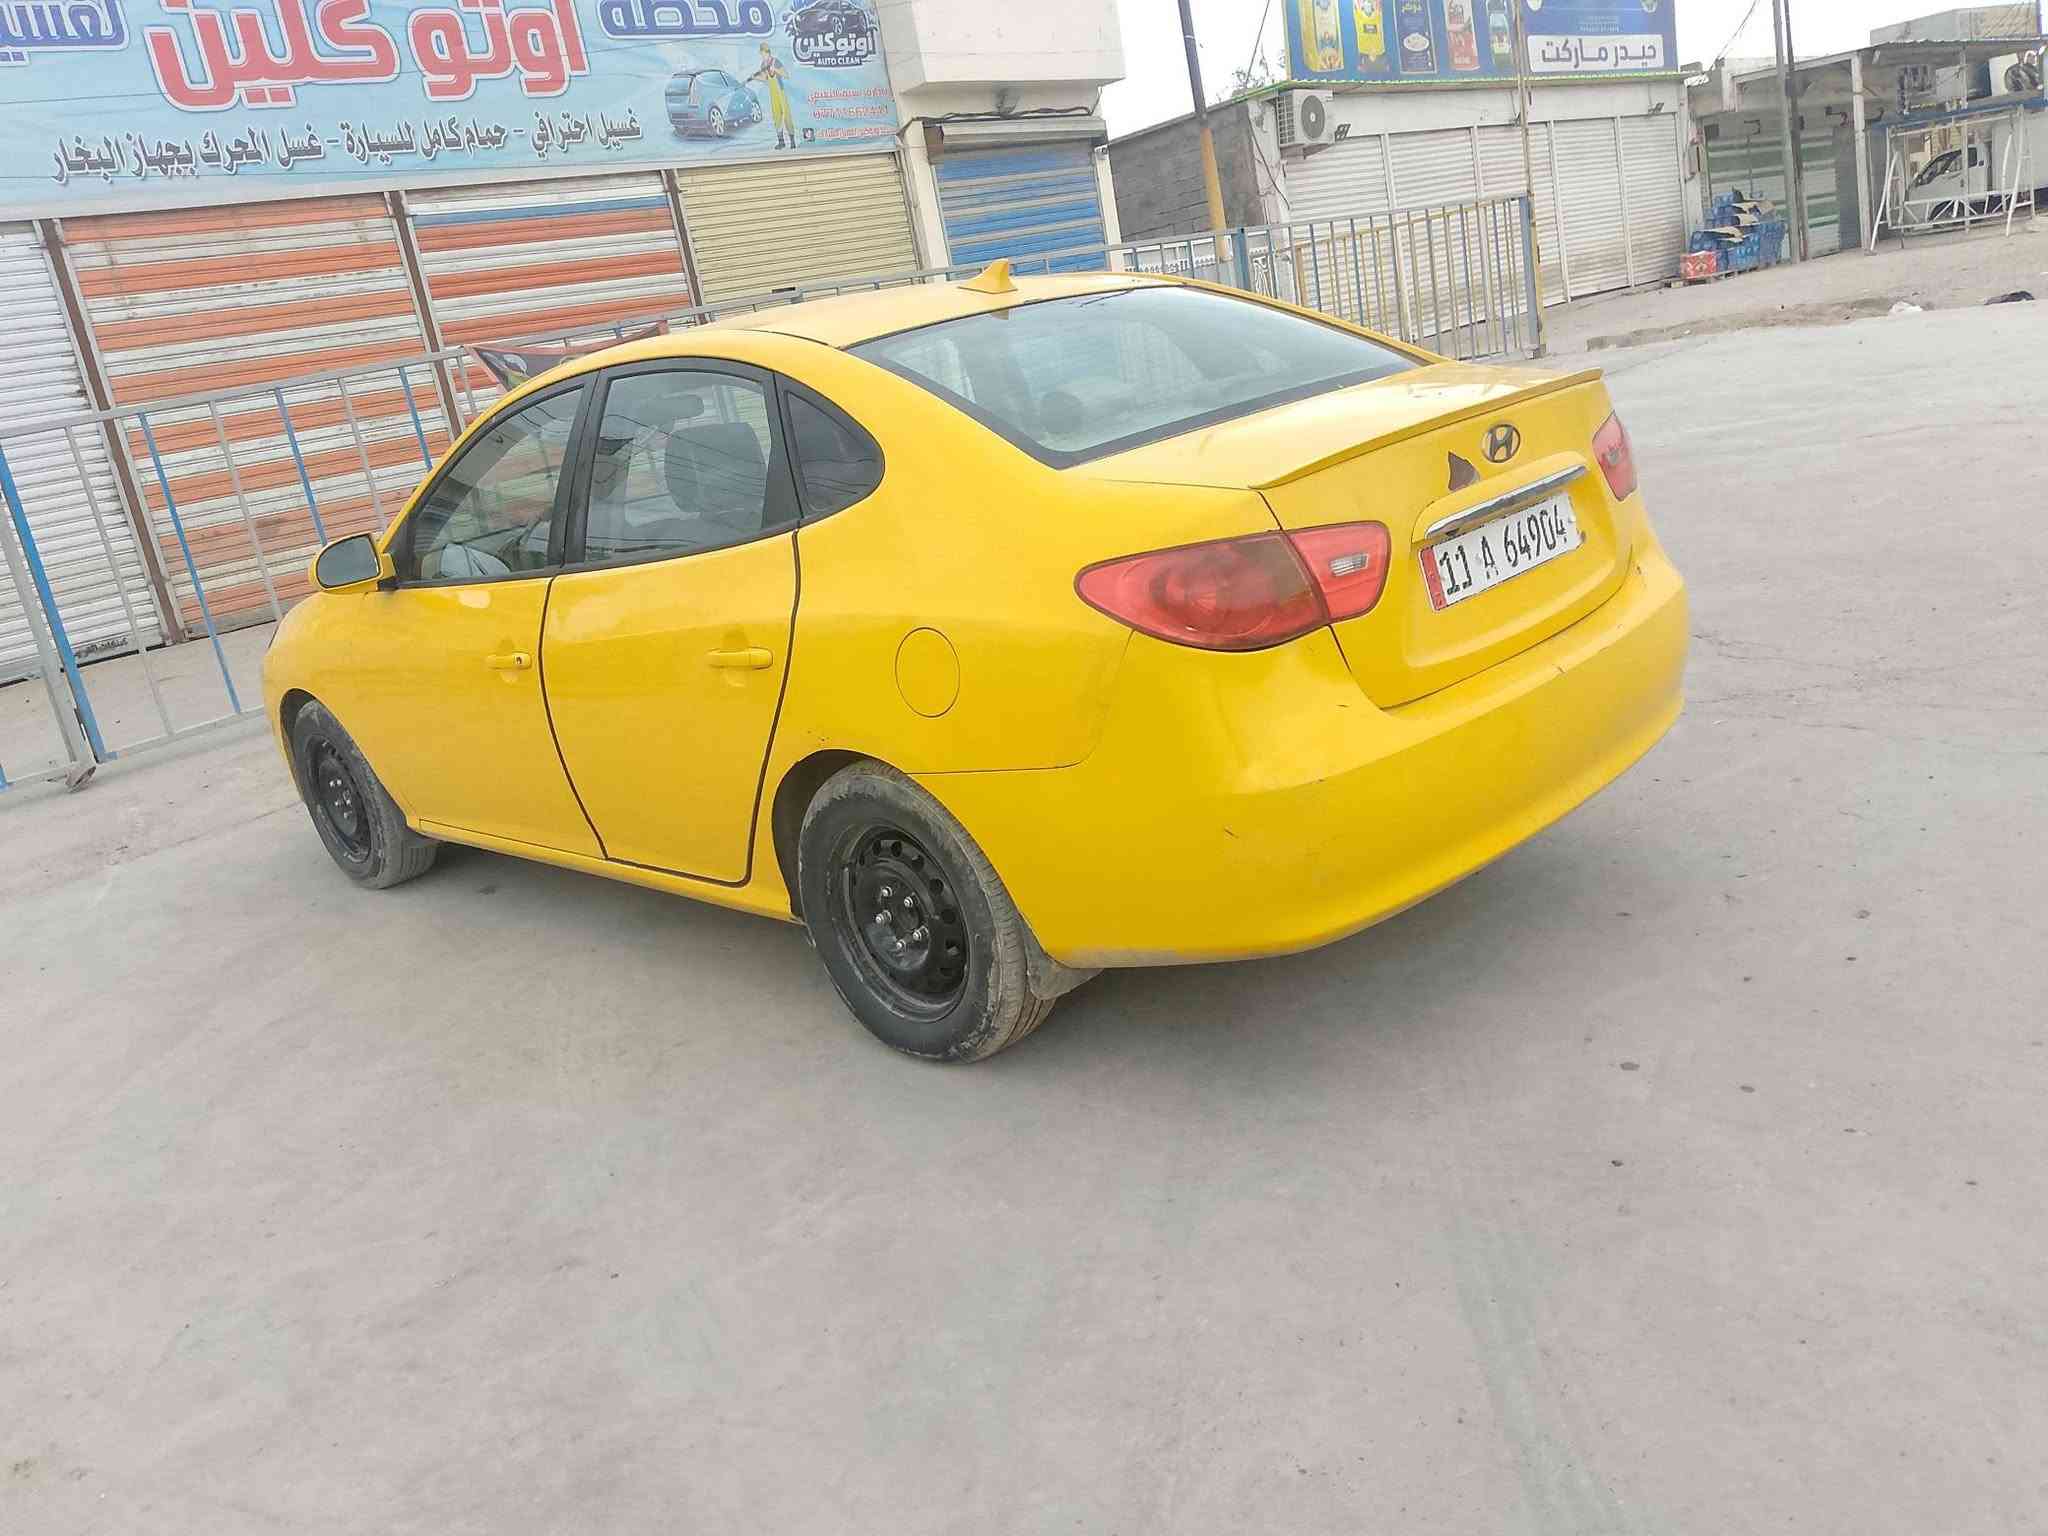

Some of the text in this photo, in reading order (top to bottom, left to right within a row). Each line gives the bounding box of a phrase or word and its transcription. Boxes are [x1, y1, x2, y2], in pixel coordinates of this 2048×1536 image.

[817, 56, 860, 65] AUTO CLEAN
[1541, 38, 1656, 68] حيدر ماركت
[278, 121, 322, 167] غسل
[339, 119, 415, 162] للسيارة
[421, 116, 462, 157] كامل
[464, 117, 506, 153] حمام
[532, 111, 593, 158] احترافي
[599, 107, 641, 148] غسيل
[51, 135, 125, 183] البخار
[199, 126, 271, 173] المحرك
[1439, 545, 1472, 595] 11
[1481, 536, 1500, 579] A
[1503, 505, 1567, 567] 64904
